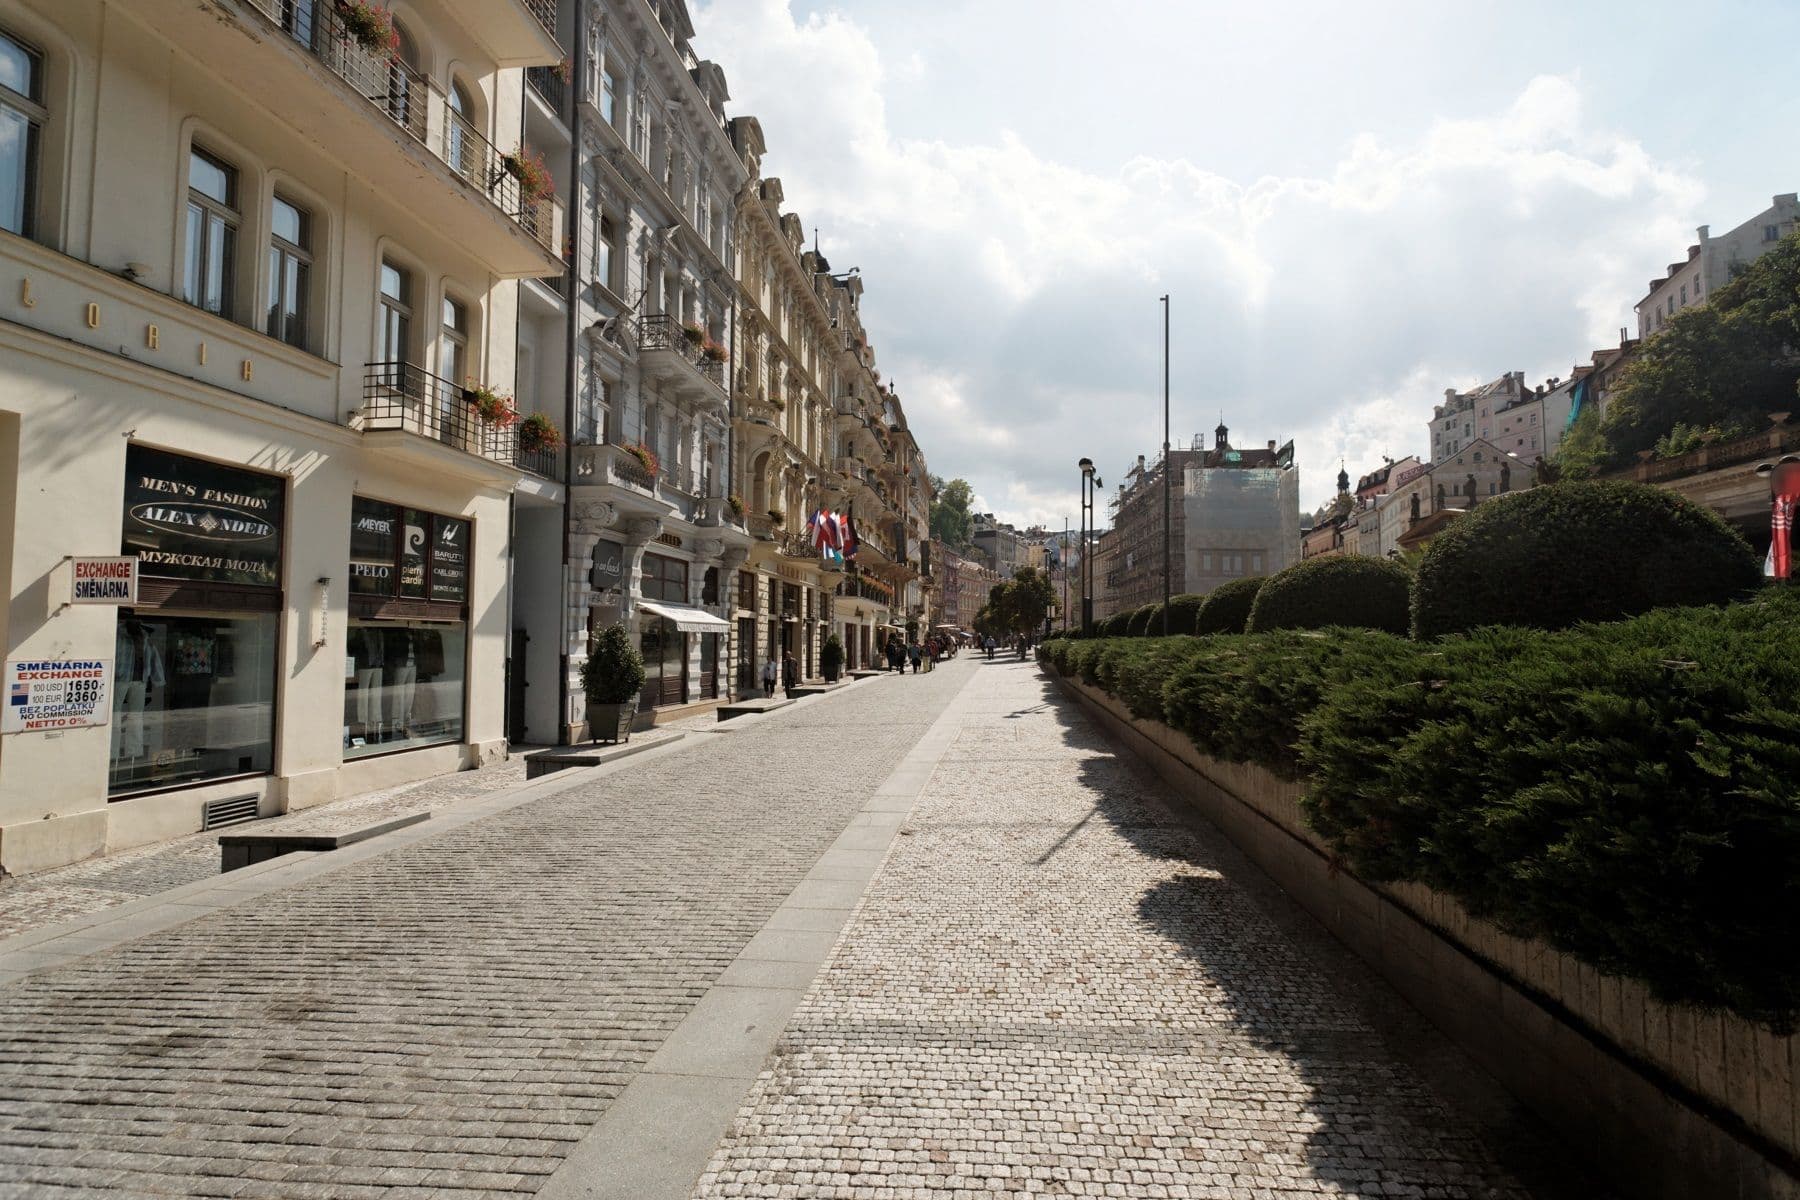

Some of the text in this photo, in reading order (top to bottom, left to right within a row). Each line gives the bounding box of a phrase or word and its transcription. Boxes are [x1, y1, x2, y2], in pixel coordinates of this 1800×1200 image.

[139, 477, 270, 510] MEN'S FASHION
[357, 517, 391, 533] MEYER
[138, 550, 266, 573] МУЖСКАЯ МОДА
[76, 562, 130, 579] EXCHANGE
[355, 563, 388, 578] PELO
[401, 576, 424, 585] cardin
[75, 578, 129, 598] SMĚNÁRNA
[16, 661, 103, 670] SMĚNÁRNA
[18, 670, 103, 680] EXCHANGE
[34, 684, 45, 692] 100
[46, 683, 62, 692] USD
[33, 695, 44, 703] 100
[45, 695, 62, 703] EUR
[20, 703, 95, 714] BEZ POPLATKU
[37, 710, 93, 719] COMMISSION
[26, 717, 87, 728] NETTO 0%
